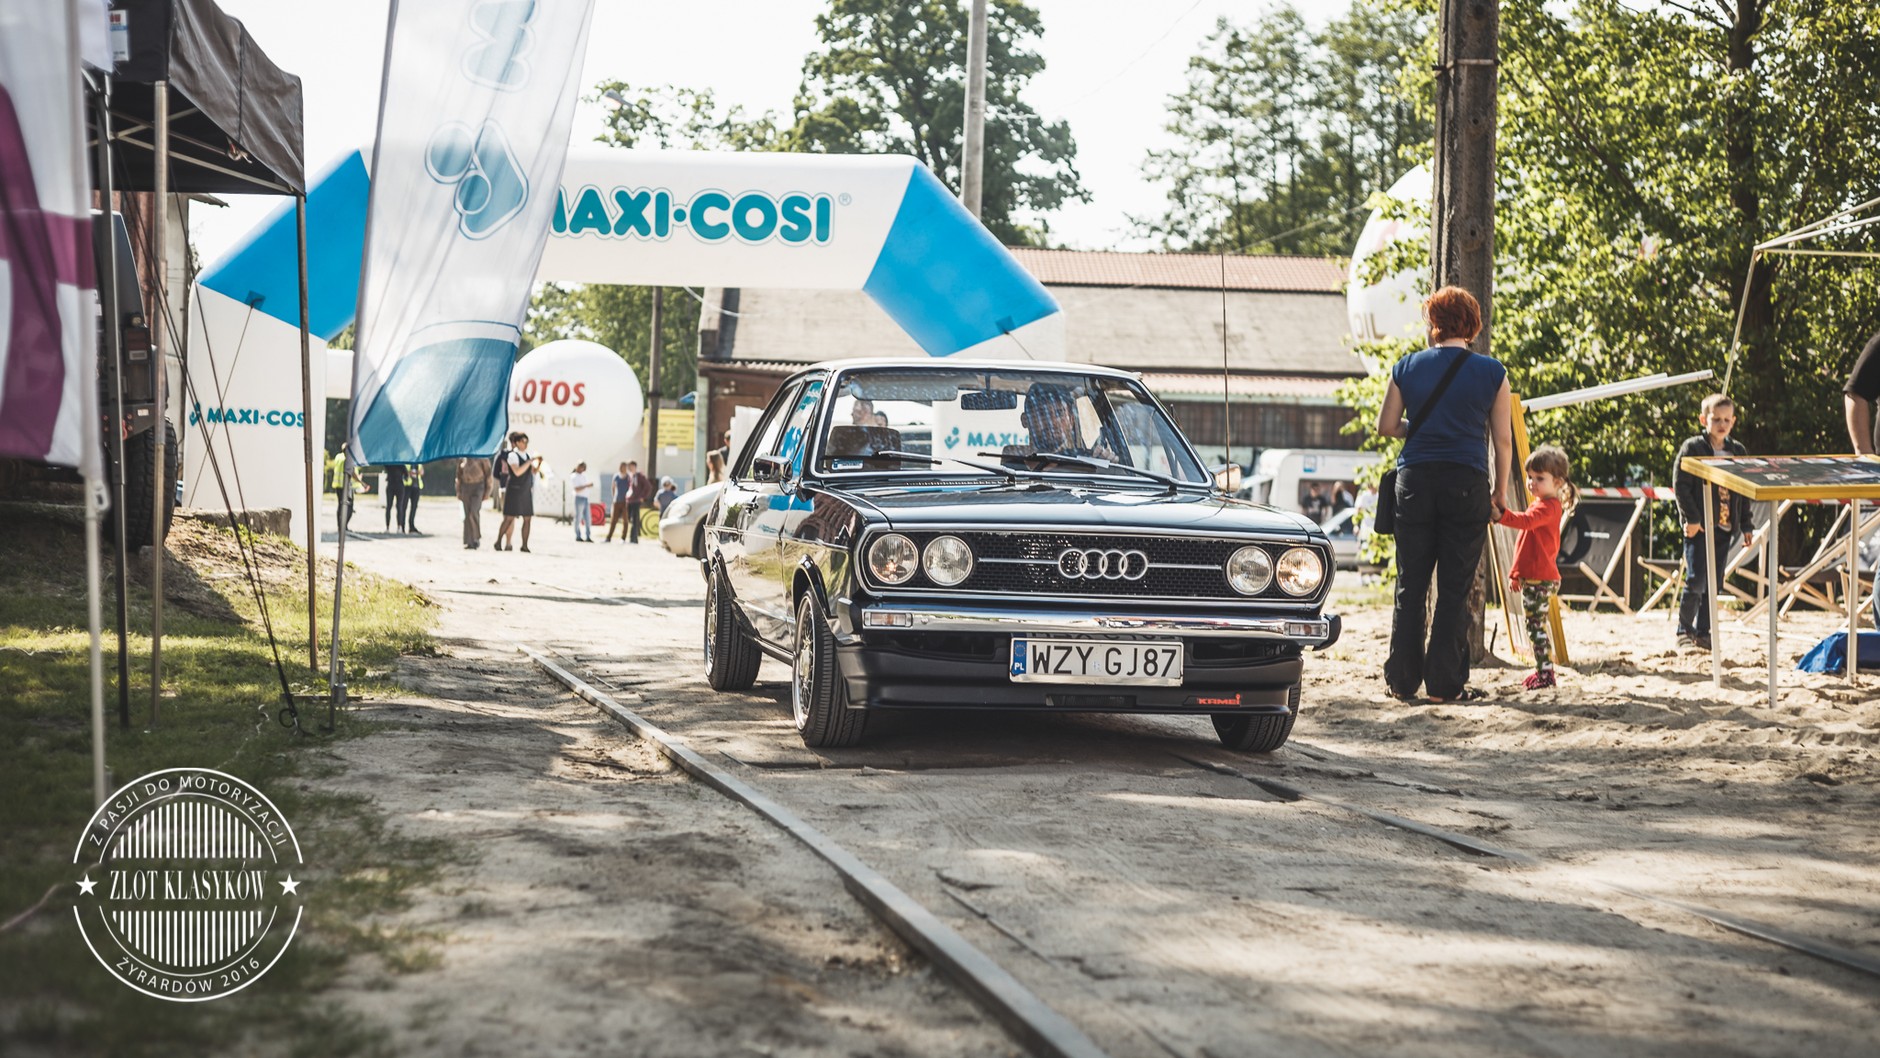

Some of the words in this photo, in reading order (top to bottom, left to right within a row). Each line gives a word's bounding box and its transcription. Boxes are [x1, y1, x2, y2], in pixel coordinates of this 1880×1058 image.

[514, 378, 585, 407] LOTOS
[551, 415, 583, 428] OIL
[1014, 662, 1025, 671] PL
[1032, 644, 1094, 675] WZY
[1105, 647, 1177, 677] GJ87
